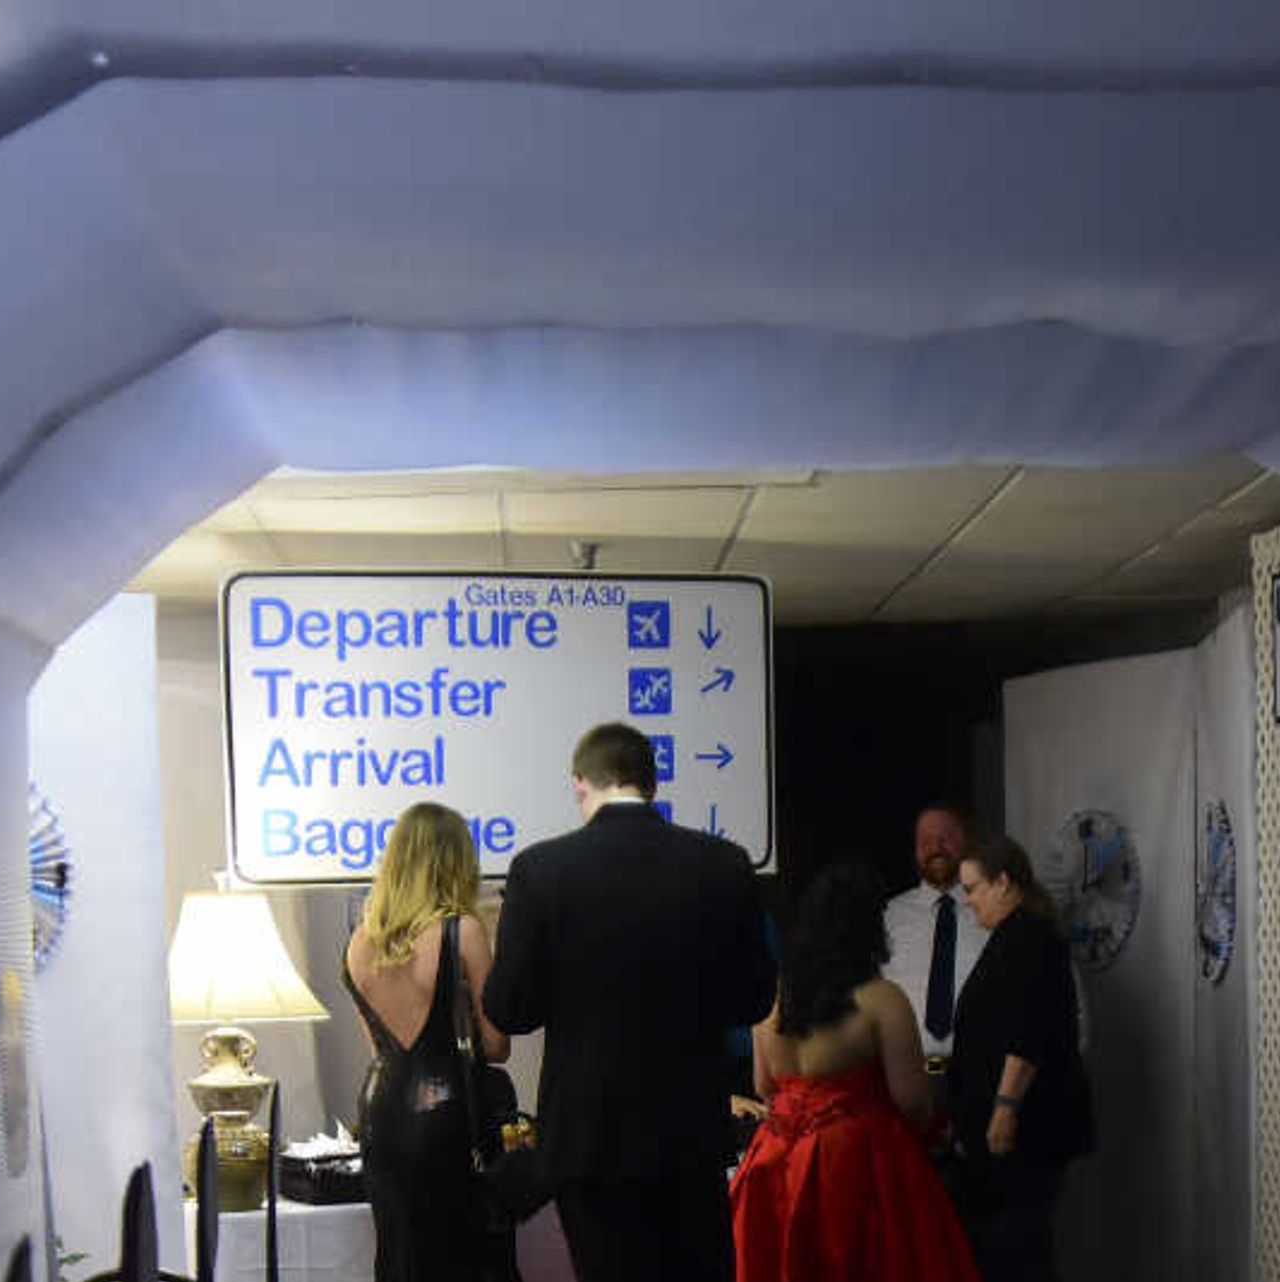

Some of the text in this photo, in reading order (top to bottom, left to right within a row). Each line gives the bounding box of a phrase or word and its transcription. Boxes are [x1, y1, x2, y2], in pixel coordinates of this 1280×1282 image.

[465, 583, 626, 607] Gates A1-A30
[250, 597, 559, 661] Departure
[252, 667, 507, 719] Transfer
[258, 736, 446, 788] Arrival
[262, 808, 515, 870] Bage
